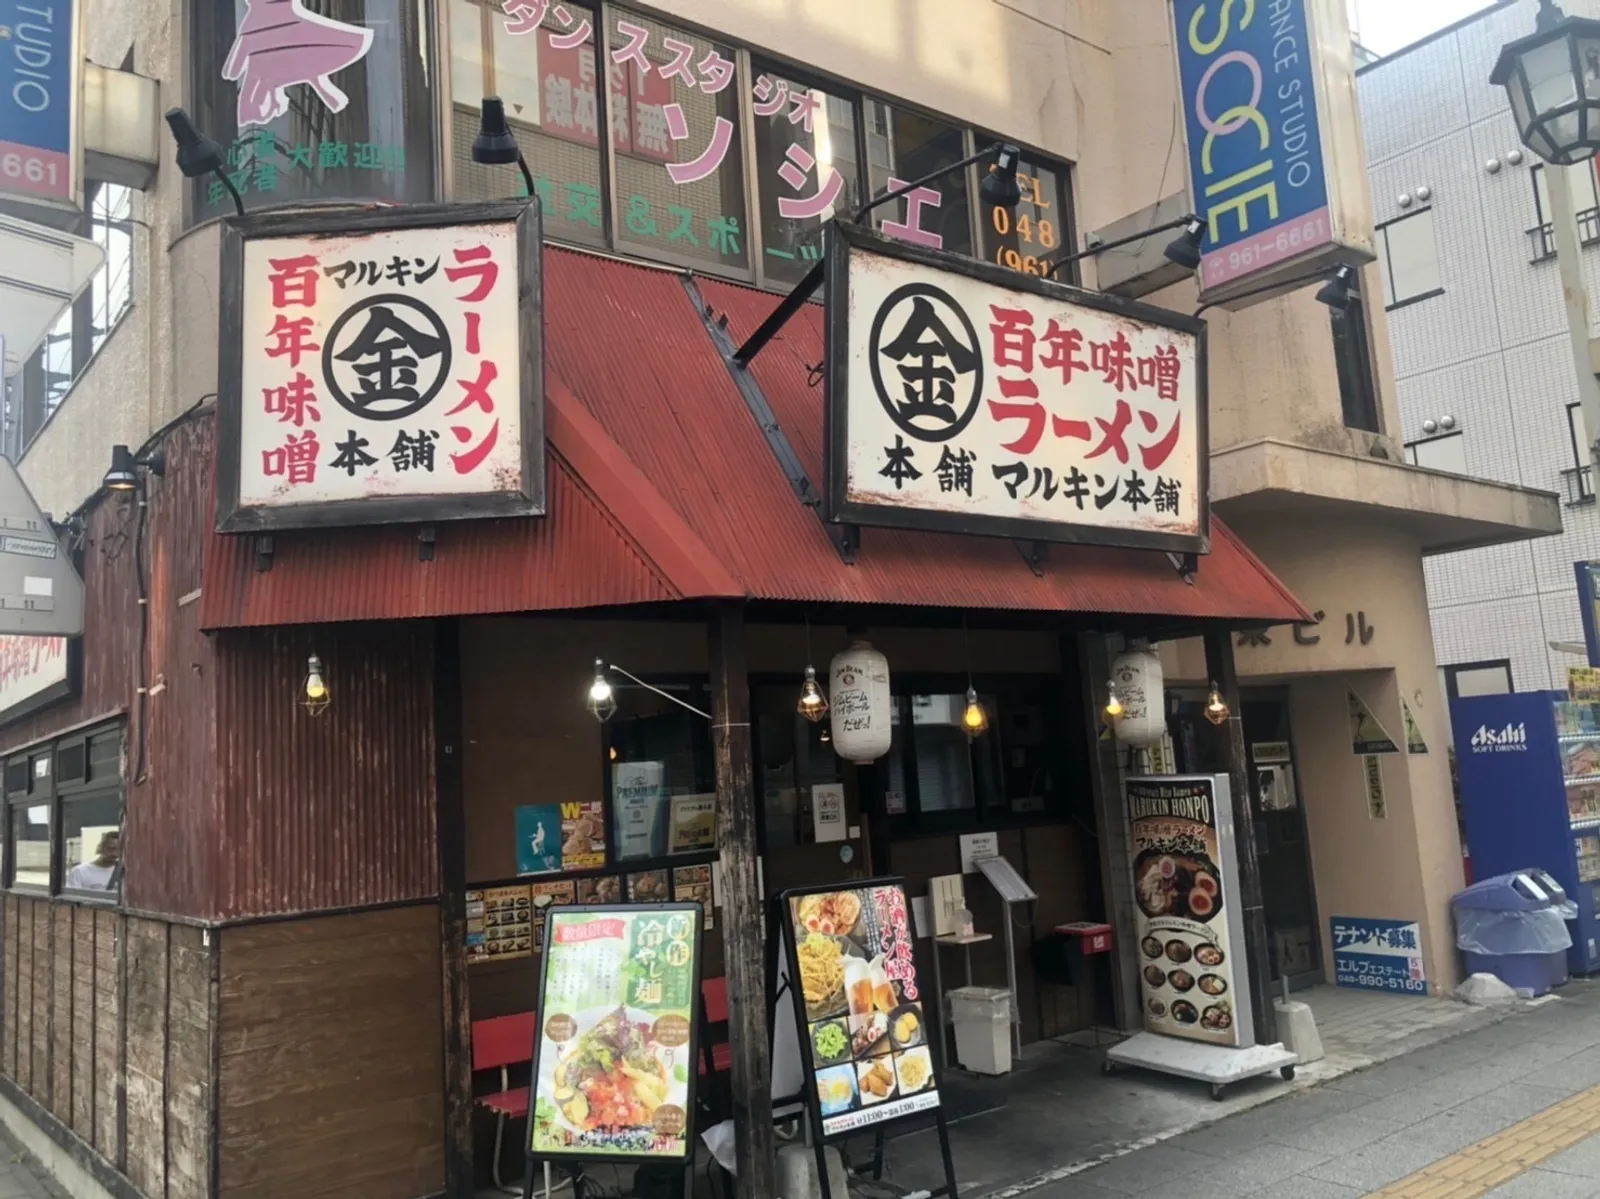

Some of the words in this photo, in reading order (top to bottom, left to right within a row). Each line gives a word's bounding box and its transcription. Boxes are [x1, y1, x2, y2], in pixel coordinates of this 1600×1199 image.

[502, 0, 822, 133] ダンススタジオ
[226, 131, 278, 166] 心者
[1189, 0, 1279, 244] SOCIE
[1278, 79, 1311, 188] STUDIO
[988, 163, 1051, 209] EL
[993, 206, 1055, 249] 048
[323, 255, 441, 289] マルキン
[262, 254, 321, 485] 百年味噌
[328, 300, 450, 414] 金
[444, 245, 499, 474] ラーメン
[876, 290, 981, 428] 金
[989, 304, 1181, 402] 百年味噌
[329, 429, 441, 476] 本舗
[987, 375, 1181, 471] ラーメン
[879, 434, 977, 497] 本舗
[992, 461, 1182, 516] マルキン本舗
[1471, 722, 1526, 745] Asahi
[1473, 745, 1493, 753] SOFT
[1495, 744, 1527, 752] DRINKS
[1171, 794, 1210, 824] HONPO
[1334, 926, 1417, 950] テナント募集
